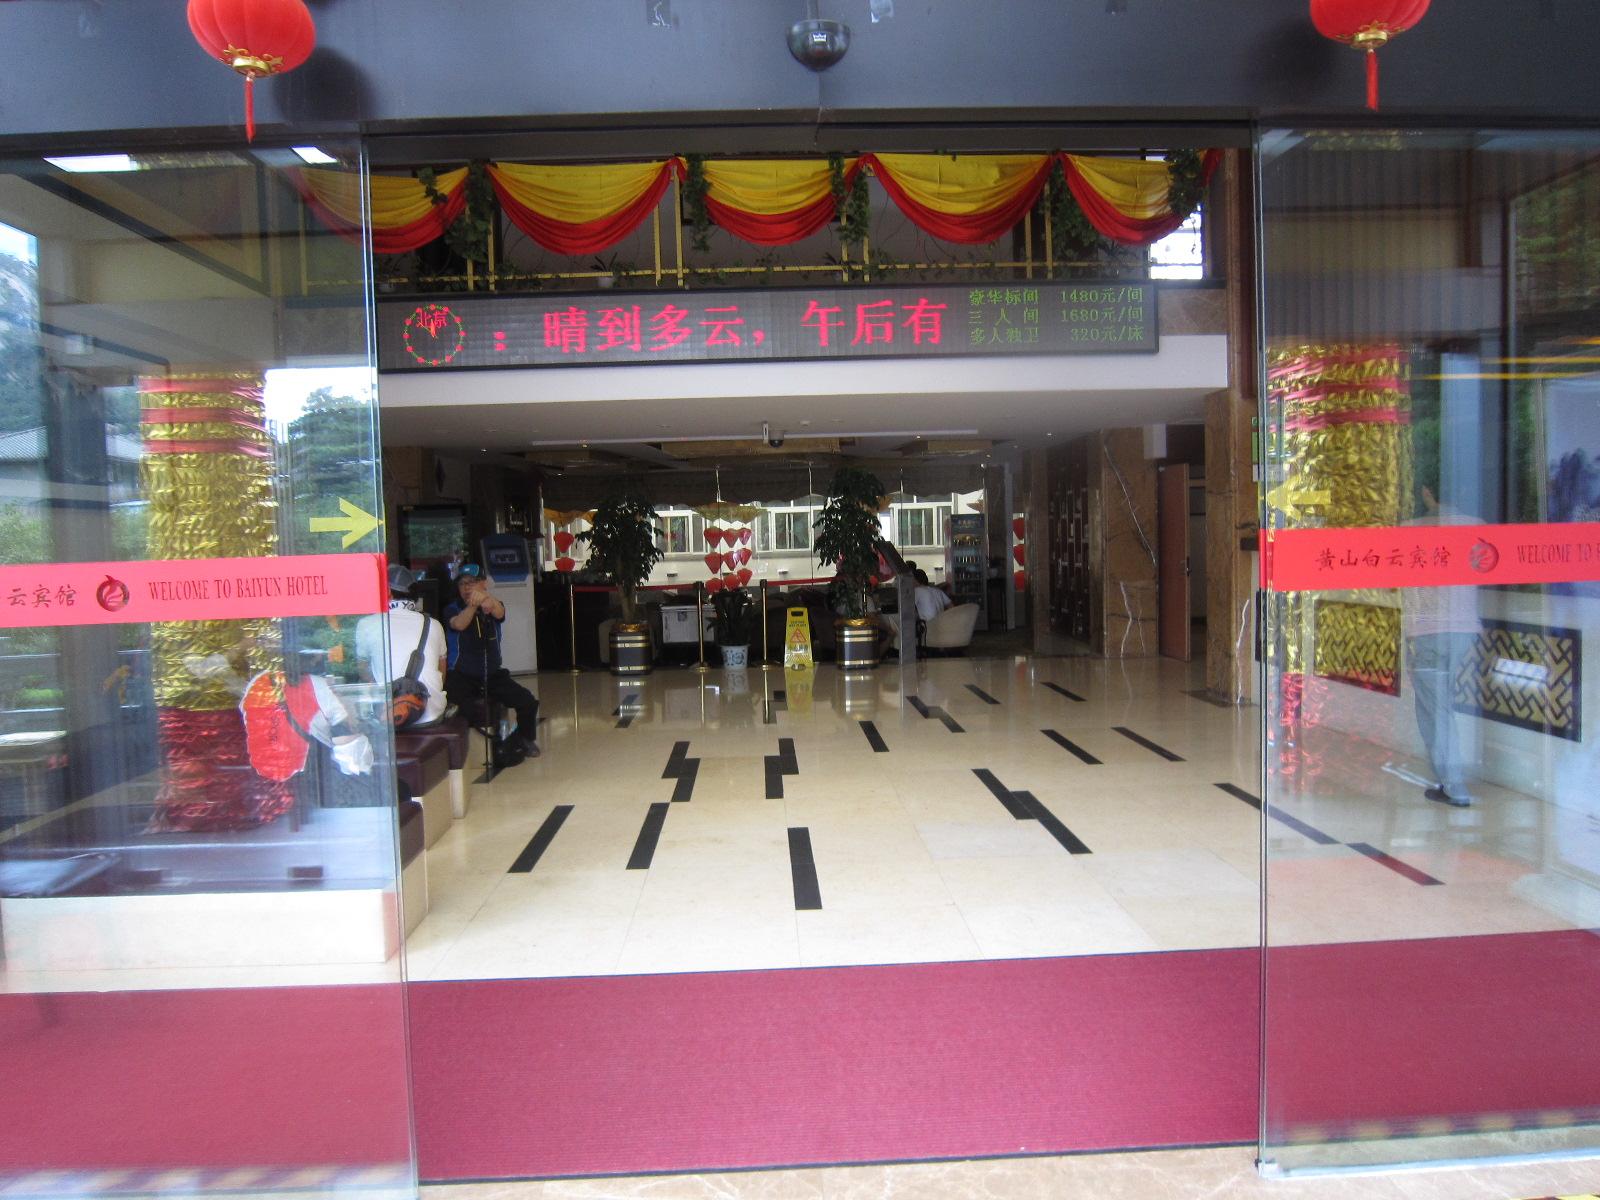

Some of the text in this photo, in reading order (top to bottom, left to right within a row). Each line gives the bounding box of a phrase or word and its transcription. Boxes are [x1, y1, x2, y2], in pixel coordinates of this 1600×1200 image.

[416, 310, 448, 328] 北京
[1315, 545, 1451, 571] 黄山白云宾馆
[1517, 544, 1572, 563] WELCOME
[7, 584, 77, 608] 云宾馆
[148, 575, 328, 600] WELCOME TO BAIYUN HOTEL
